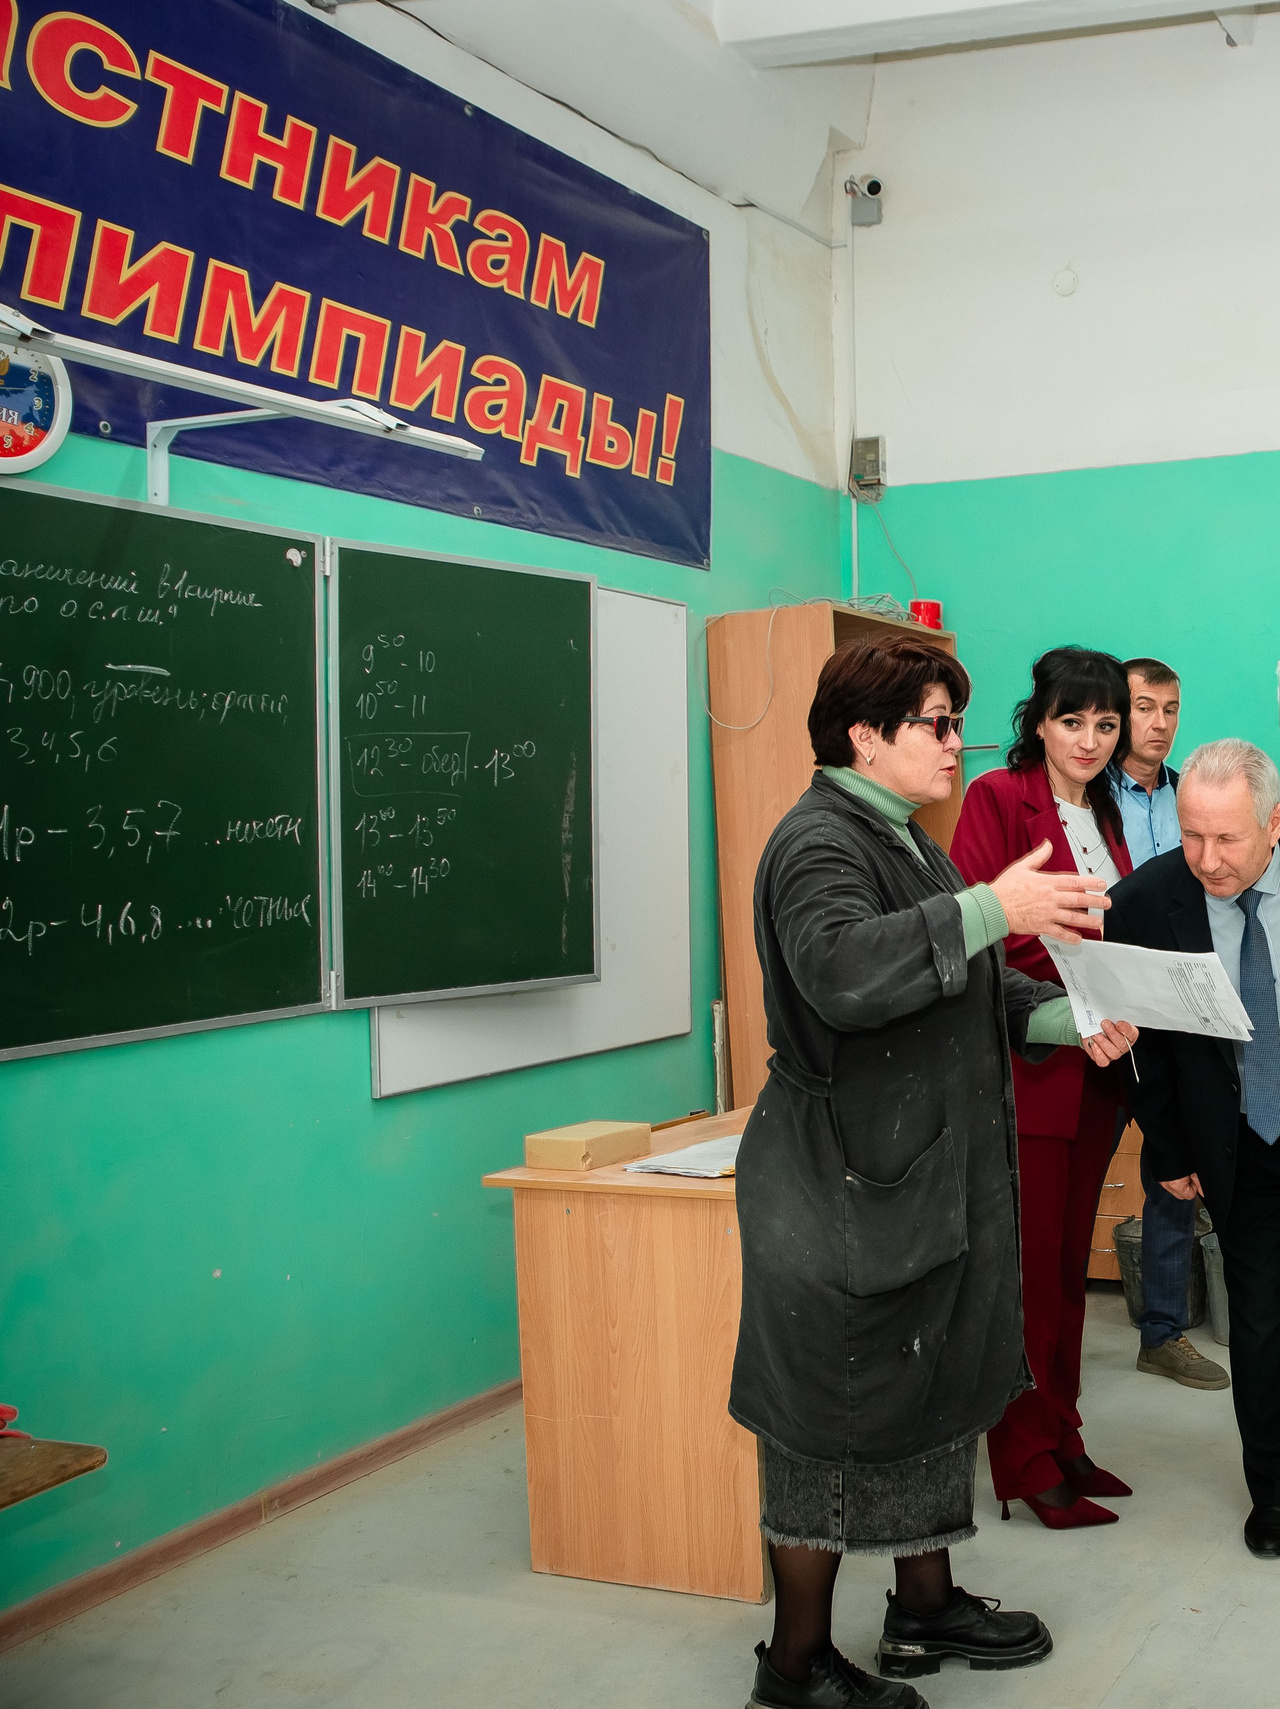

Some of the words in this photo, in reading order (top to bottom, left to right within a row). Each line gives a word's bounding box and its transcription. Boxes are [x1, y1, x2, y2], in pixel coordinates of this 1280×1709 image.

[29, 368, 38, 382] 2
[34, 397, 43, 410] 3
[24, 422, 35, 436] 4
[4, 434, 13, 448] 5
